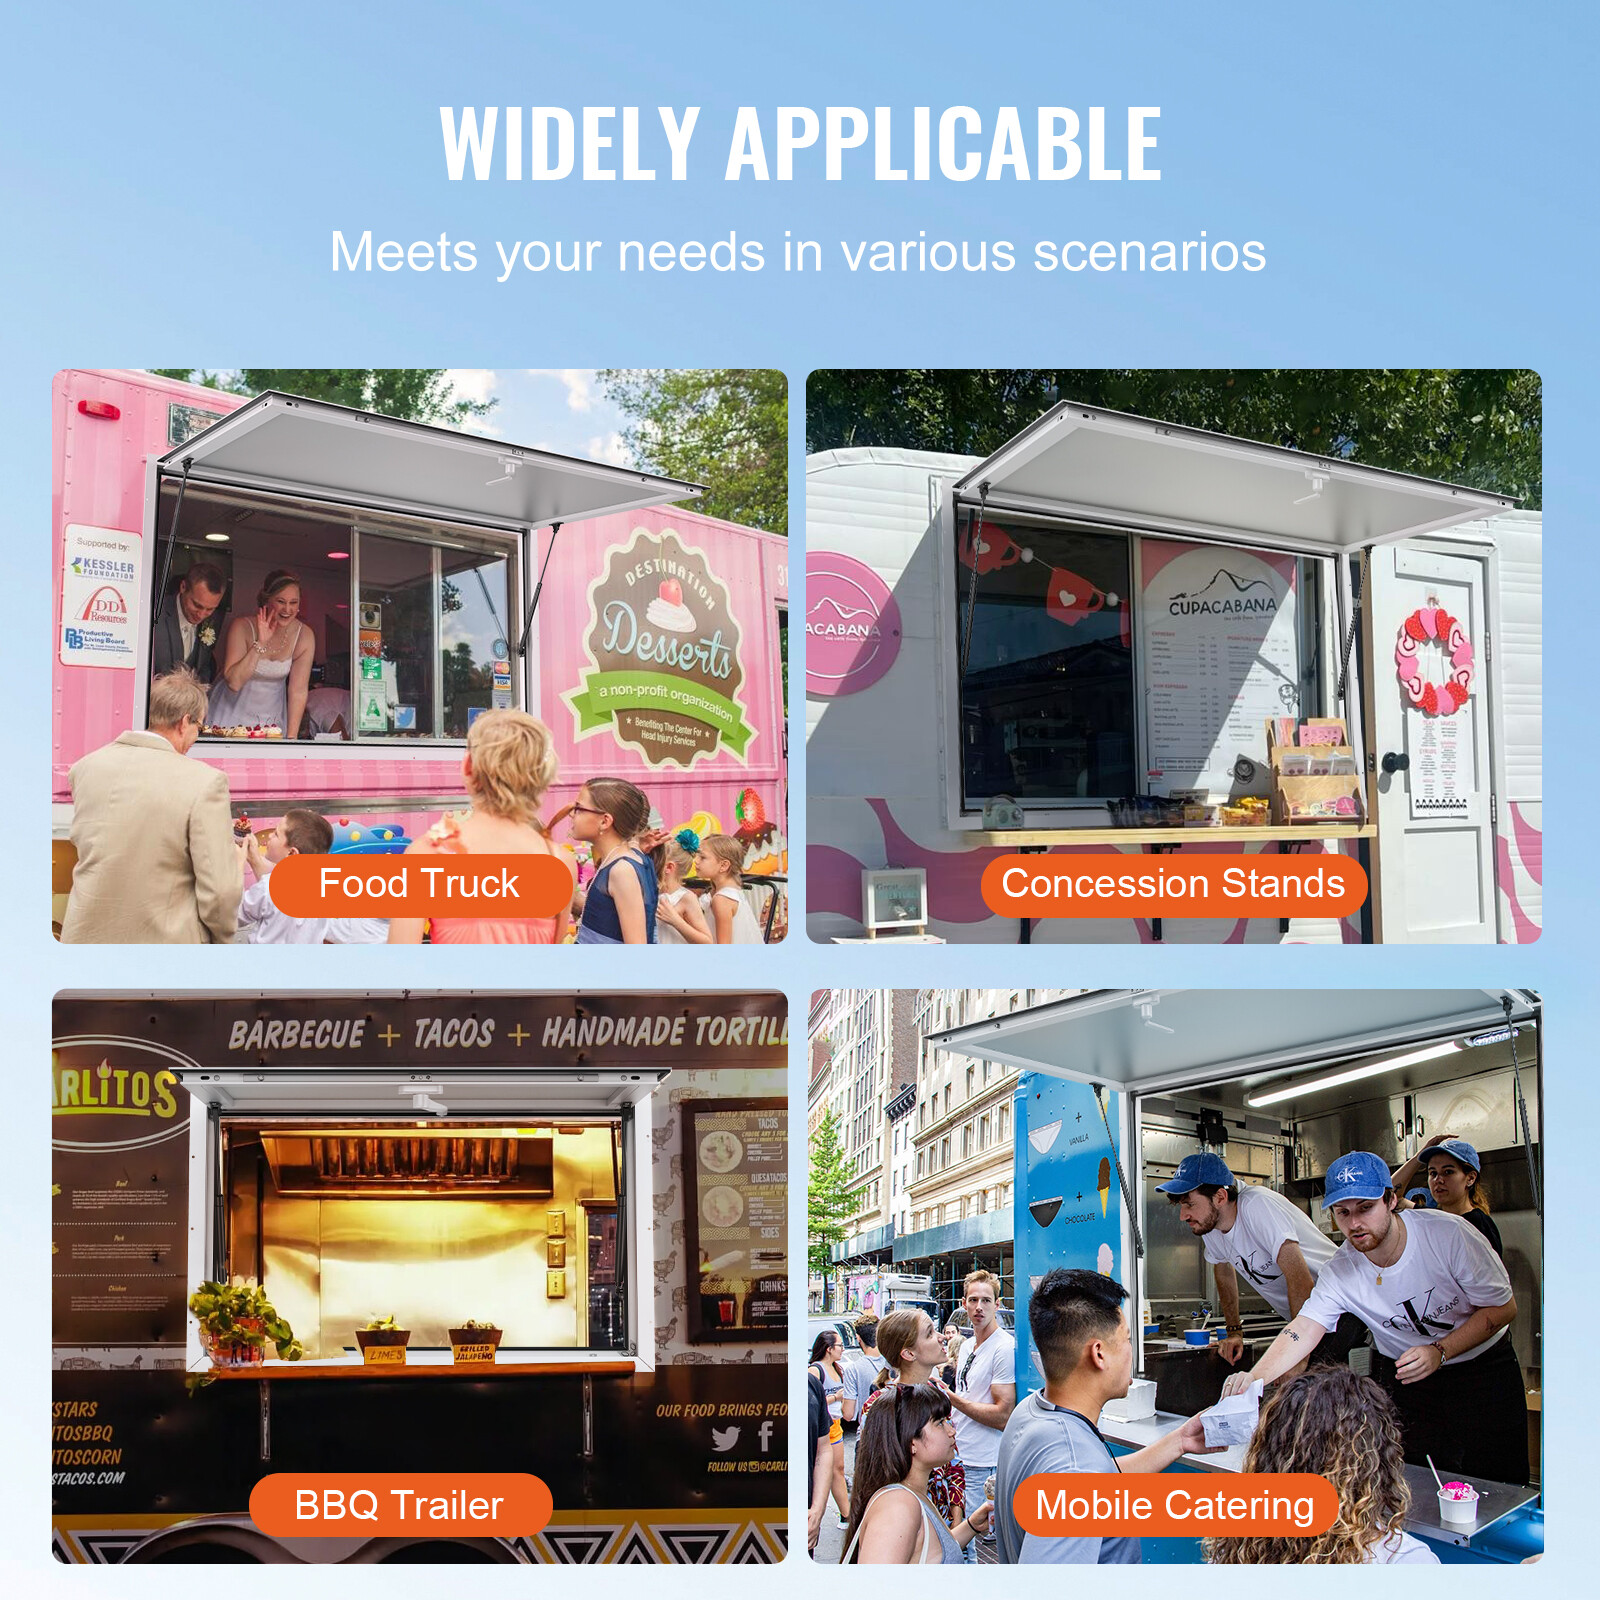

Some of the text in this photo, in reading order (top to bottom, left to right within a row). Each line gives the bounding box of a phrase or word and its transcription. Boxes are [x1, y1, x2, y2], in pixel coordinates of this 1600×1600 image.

[76, 537, 117, 550] Supported
[83, 557, 134, 573] KESSLER
[83, 568, 134, 580] FOUNDATION
[625, 558, 716, 611] DESTINATION
[1169, 597, 1278, 617] CUPACABANA
[90, 611, 128, 624] Resources
[78, 629, 114, 638] Productive
[602, 600, 733, 679] Desserts
[84, 636, 126, 645] Living Board
[599, 685, 734, 723] a non-profit organization
[664, 722, 675, 732] The
[675, 723, 693, 736] Center
[693, 727, 703, 736] For
[641, 730, 697, 747] Head Injury Services
[228, 1018, 366, 1051] BARBECUE
[414, 1017, 495, 1050] TACOS
[541, 1015, 687, 1049] HANDMADE
[758, 1117, 779, 1129] TACOS
[1069, 1133, 1089, 1146] VANILLA
[751, 1172, 788, 1184] QUESATACOS
[1065, 1213, 1096, 1225] CHOCOLATE
[761, 1226, 780, 1238] SIDES
[760, 1280, 787, 1293] DRINKS
[1437, 1296, 1460, 1317] JEANS
[370, 1350, 402, 1360] LIMES
[656, 1404, 681, 1417] OUR
[684, 1403, 715, 1417] FOOD
[718, 1403, 762, 1416] BRINGS
[707, 1462, 737, 1473] FOLLOW
[737, 1462, 748, 1472] US
